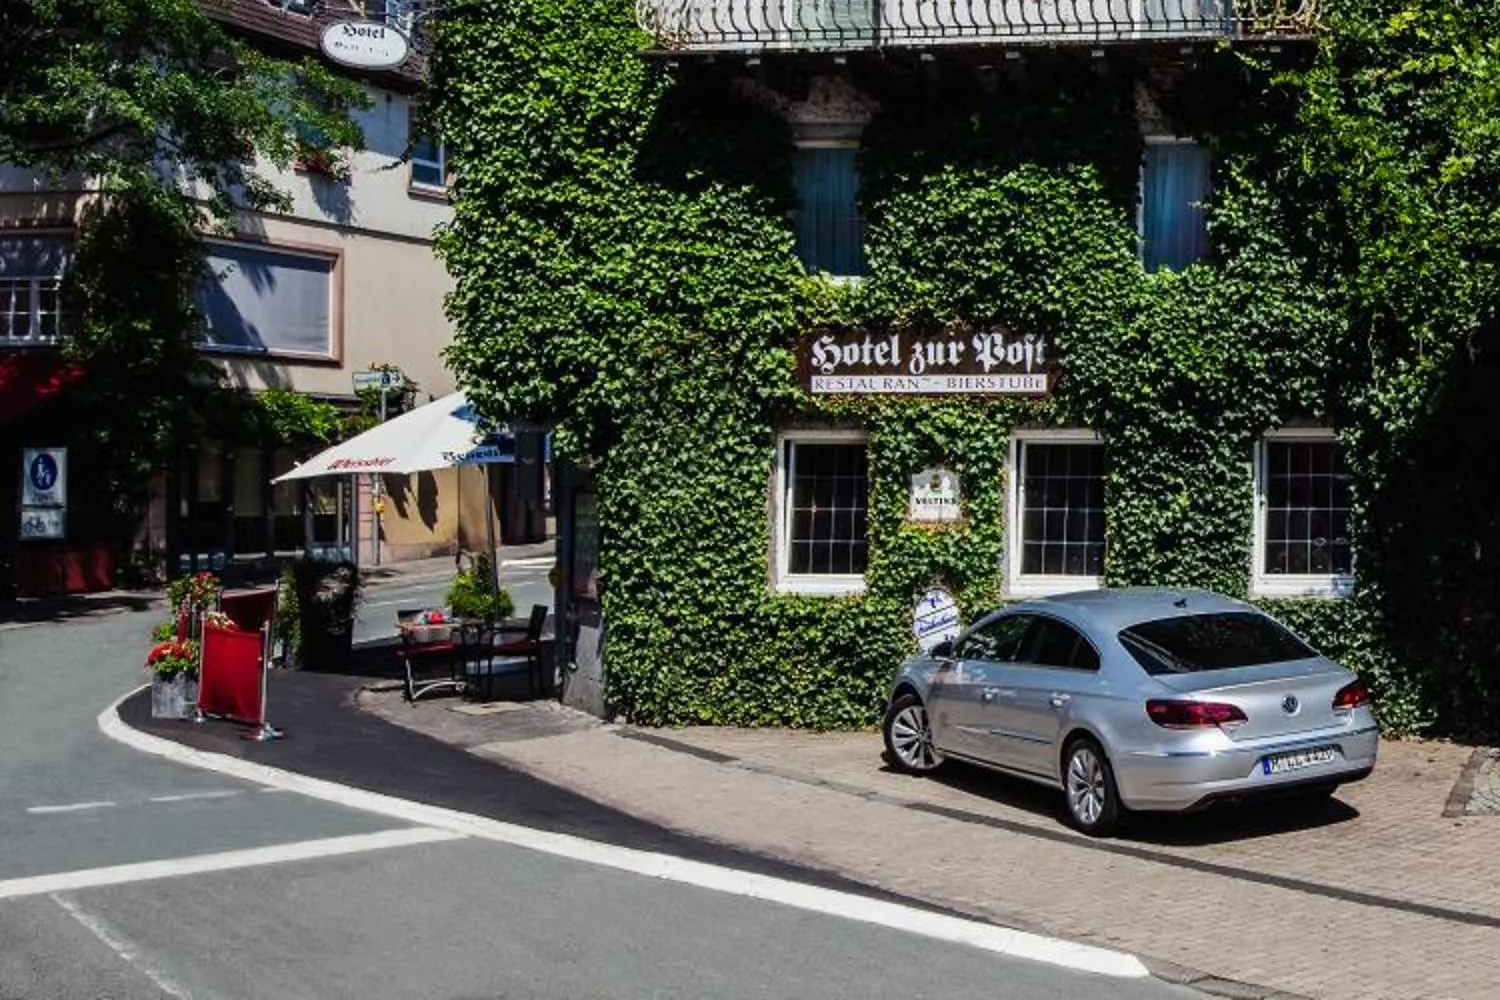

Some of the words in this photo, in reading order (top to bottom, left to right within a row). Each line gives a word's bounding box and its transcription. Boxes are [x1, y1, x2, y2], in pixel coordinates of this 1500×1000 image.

[343, 22, 386, 40] Hotel
[811, 334, 901, 375] Hotel
[909, 340, 966, 375] zur
[972, 332, 1048, 373] Post
